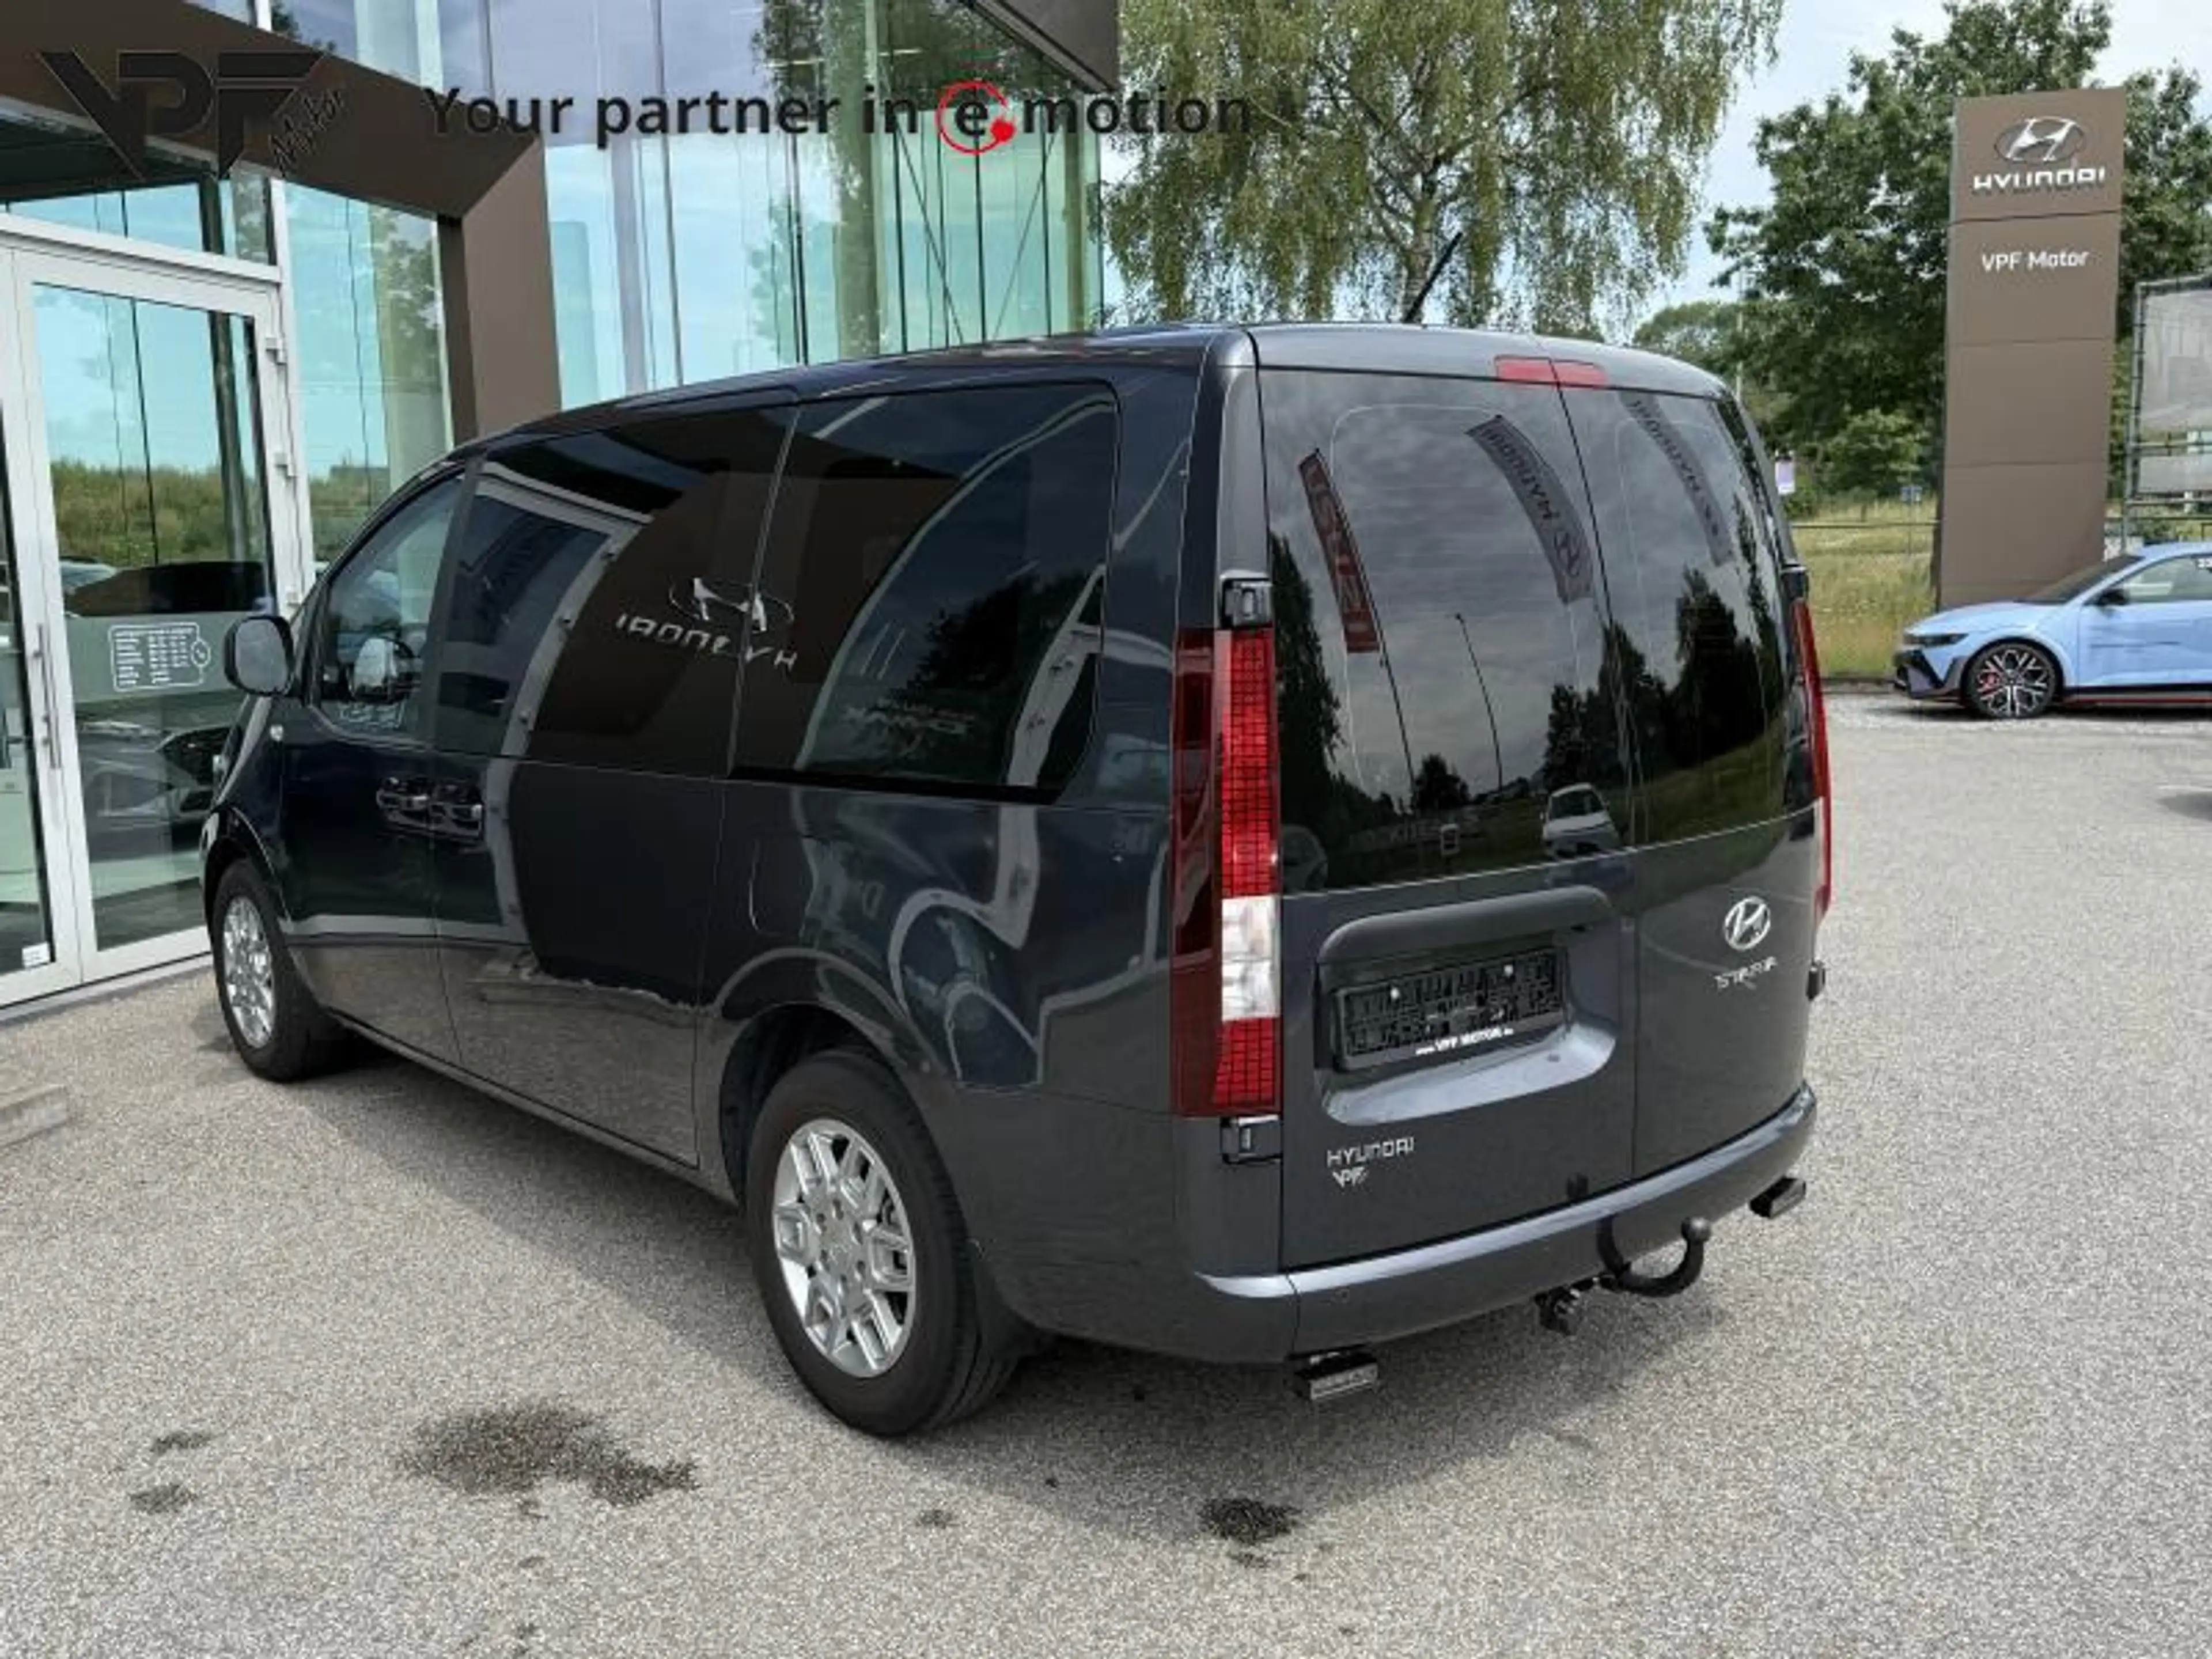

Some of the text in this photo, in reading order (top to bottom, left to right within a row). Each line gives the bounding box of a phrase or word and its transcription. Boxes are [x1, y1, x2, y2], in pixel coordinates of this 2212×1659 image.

[1973, 167, 2106, 190] HYUNDAI
[1981, 250, 2089, 272] VPF Motor
[1327, 1136, 1414, 1168] HYUNDAI
